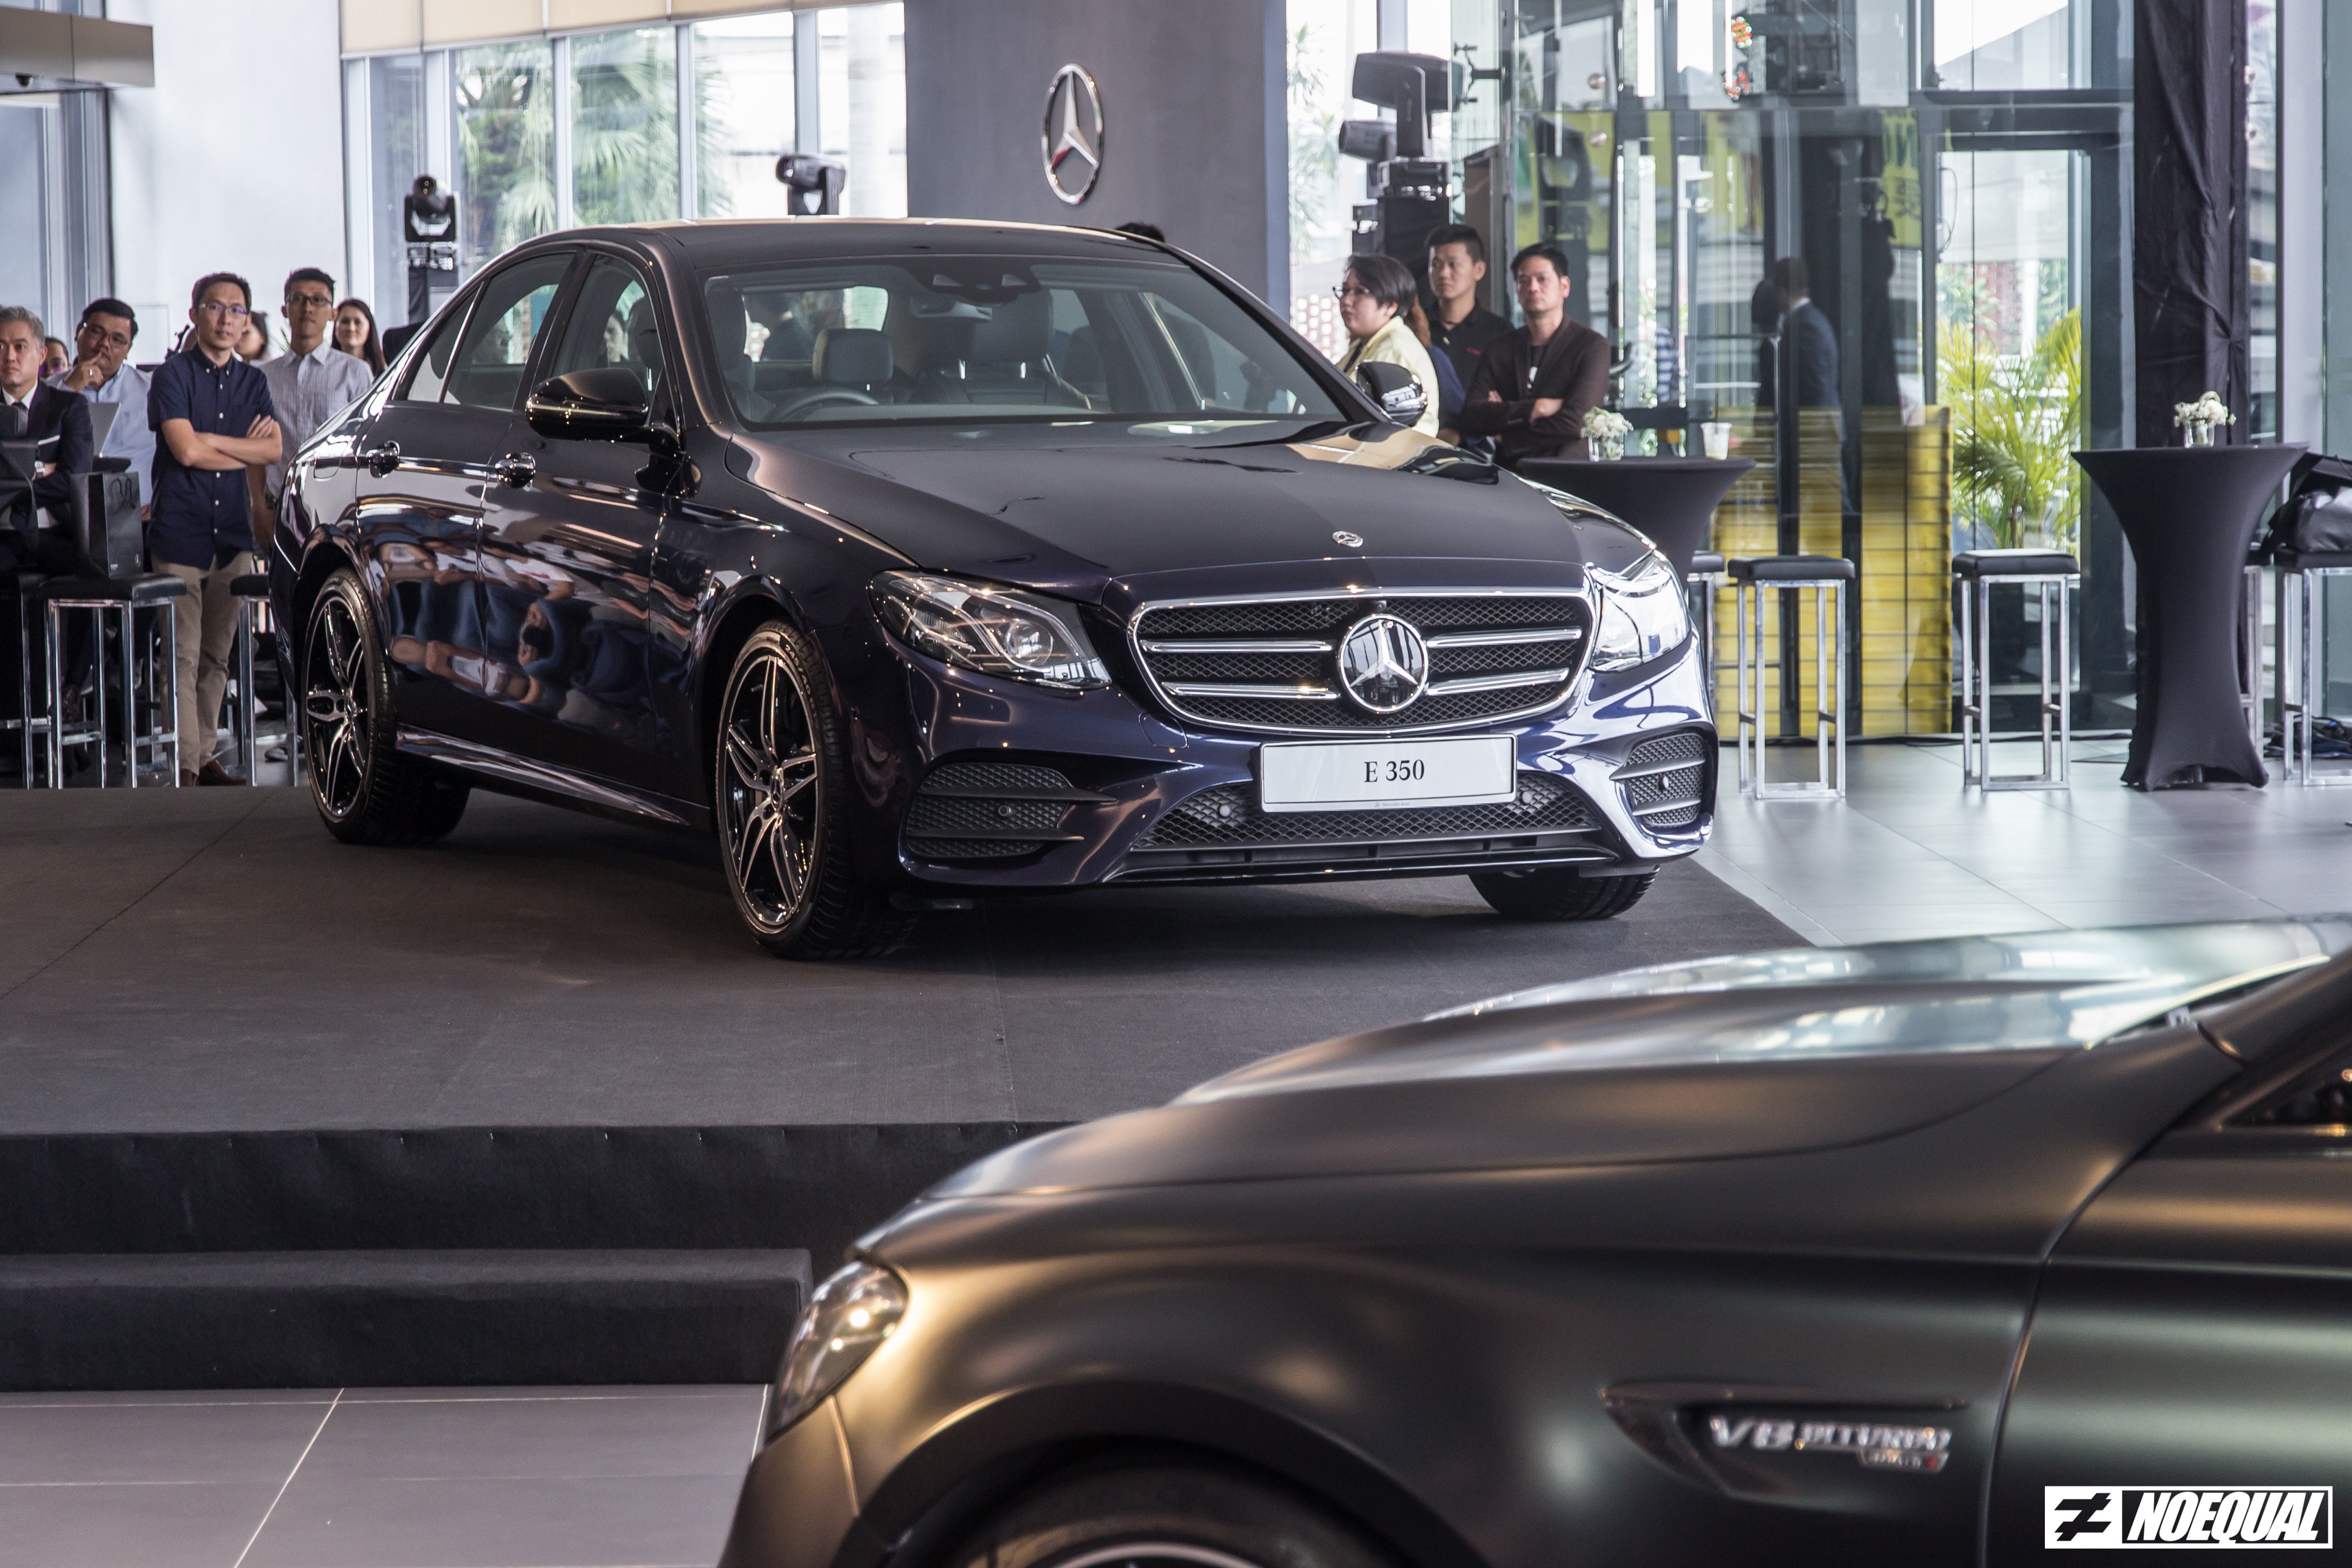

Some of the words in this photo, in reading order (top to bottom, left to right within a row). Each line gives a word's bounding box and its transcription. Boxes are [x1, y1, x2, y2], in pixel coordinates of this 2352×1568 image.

[1364, 761, 1378, 783] E
[1385, 759, 1425, 781] 350
[1709, 1415, 1796, 1450] V8
